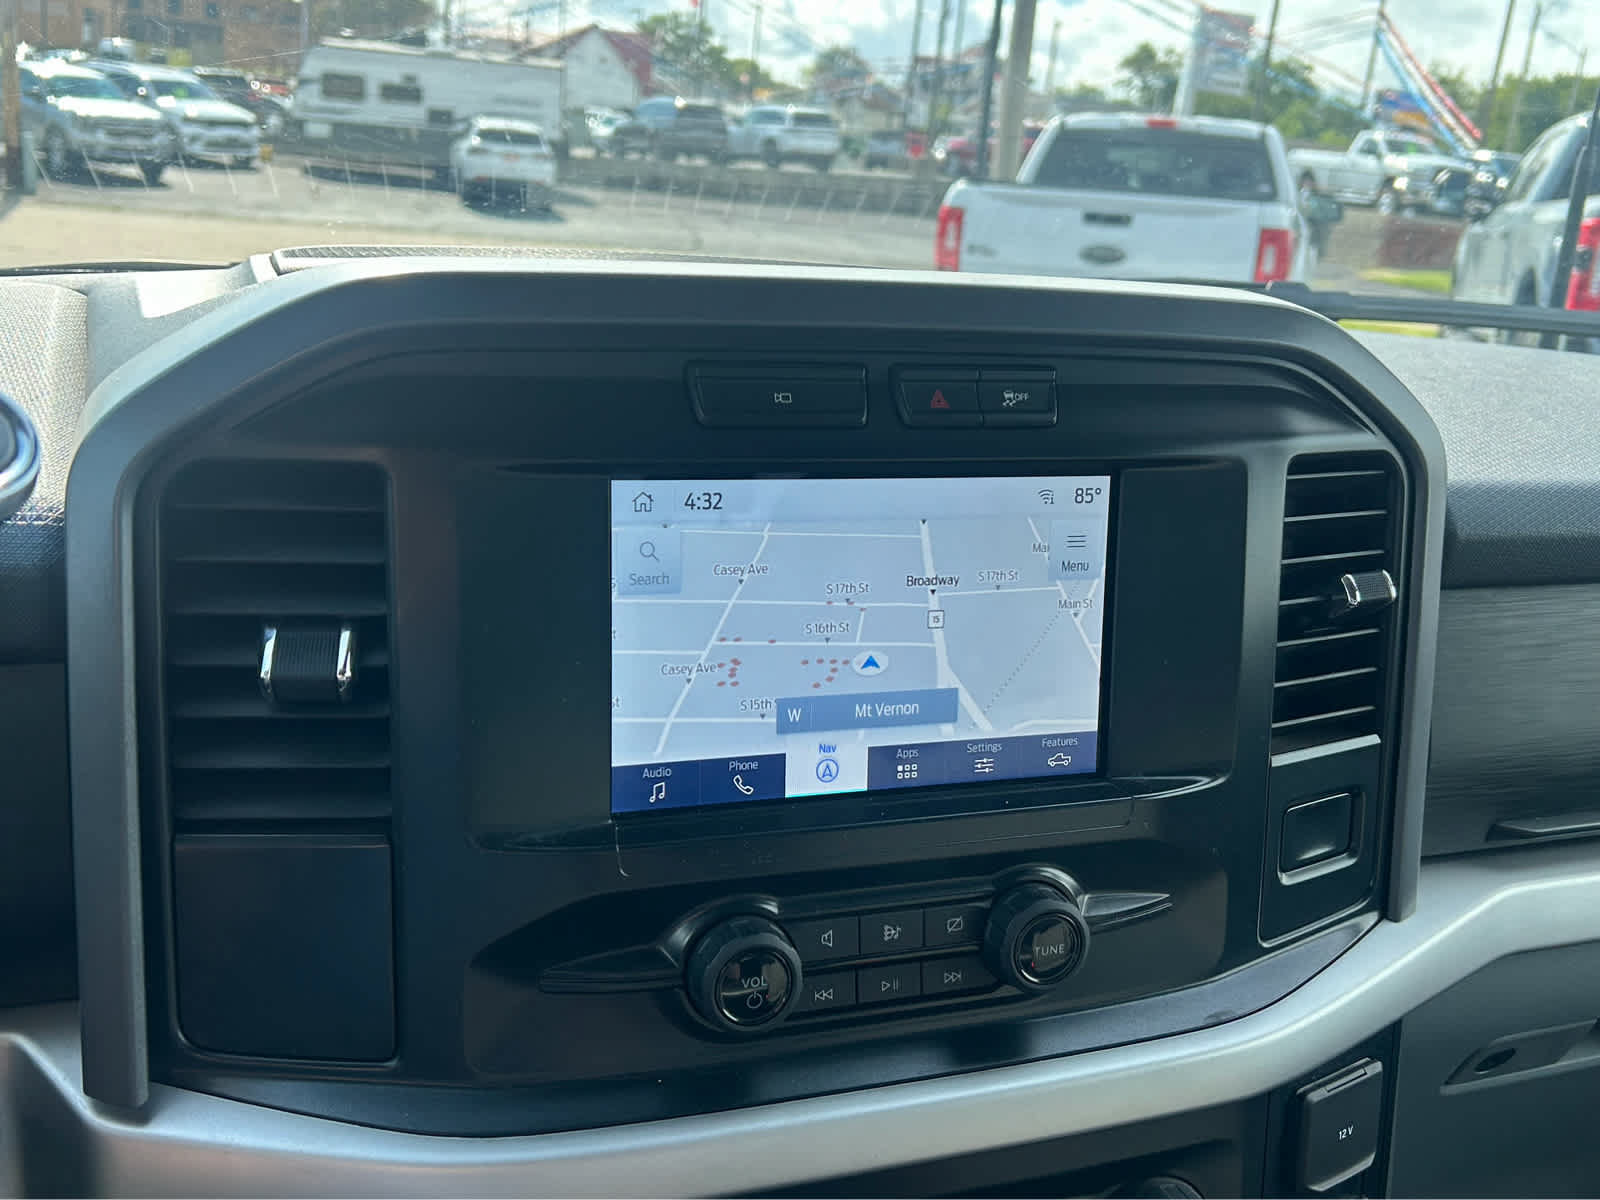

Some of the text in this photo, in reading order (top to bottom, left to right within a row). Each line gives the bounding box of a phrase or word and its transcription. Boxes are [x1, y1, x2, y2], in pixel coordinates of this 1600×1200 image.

[1014, 392, 1029, 400] OFF
[684, 492, 723, 511] 4:32
[1074, 487, 1102, 504] 85°
[713, 564, 769, 577] Casey Ave
[1061, 560, 1089, 573] Menu
[629, 572, 670, 586] Search
[906, 574, 960, 588] Broadway
[978, 570, 1018, 582] S 17th St
[826, 582, 869, 594] S 17th St
[1058, 598, 1093, 609] Main St
[805, 621, 850, 633] S 16th St
[661, 663, 717, 676] Casey Ave
[740, 699, 772, 711] S 15th
[787, 702, 919, 722] W Mt Vernon
[966, 742, 1002, 754] Settings
[1042, 736, 1078, 748] Features
[818, 743, 837, 754] Nav
[896, 748, 919, 760] Apps
[728, 760, 759, 772] Phone
[642, 767, 672, 779] Audio
[1035, 943, 1065, 957] TUNE
[741, 975, 768, 988] VOL
